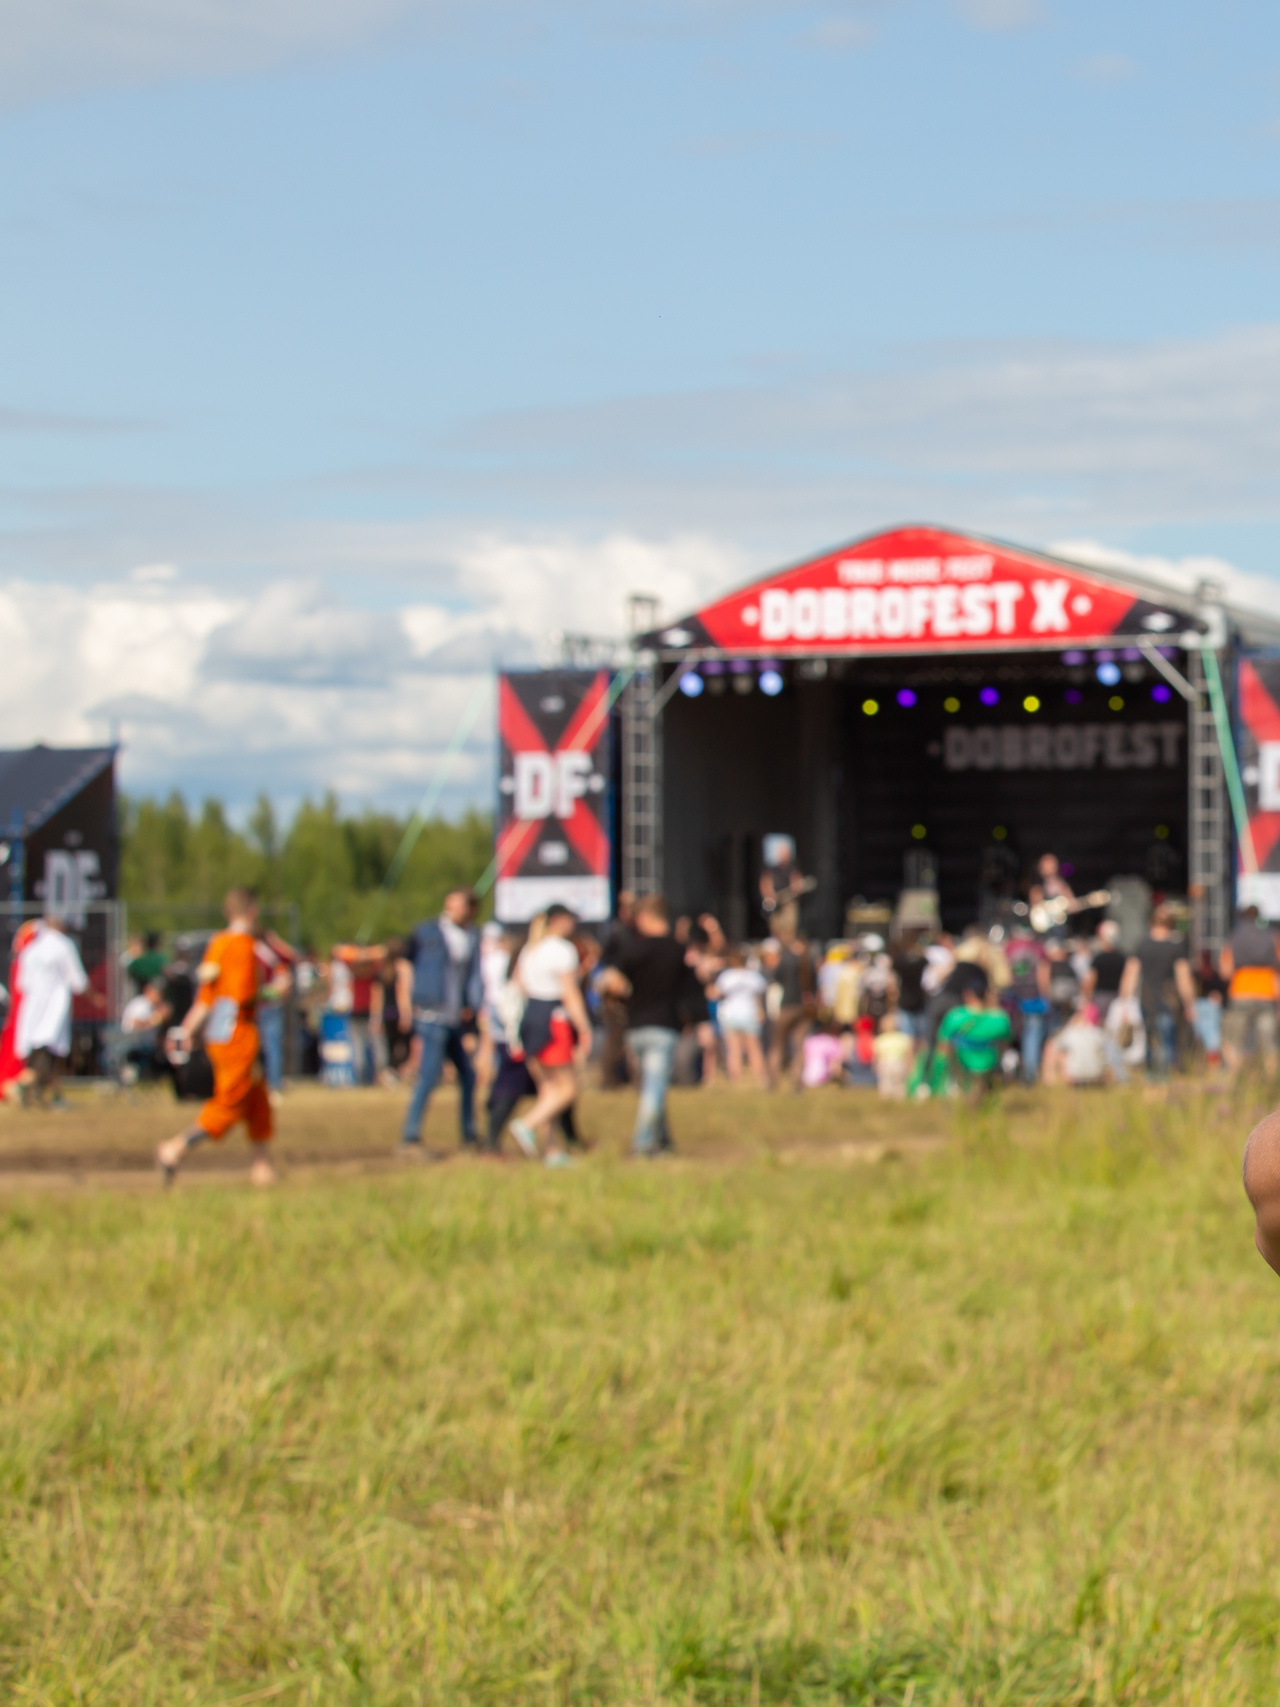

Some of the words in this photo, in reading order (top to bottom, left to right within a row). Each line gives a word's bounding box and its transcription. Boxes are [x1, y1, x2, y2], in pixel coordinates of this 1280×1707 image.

[759, 582, 1023, 640] DOBROFEST
[1030, 579, 1071, 633] X
[944, 721, 1183, 771] DOBROFEST
[514, 751, 593, 820] DF
